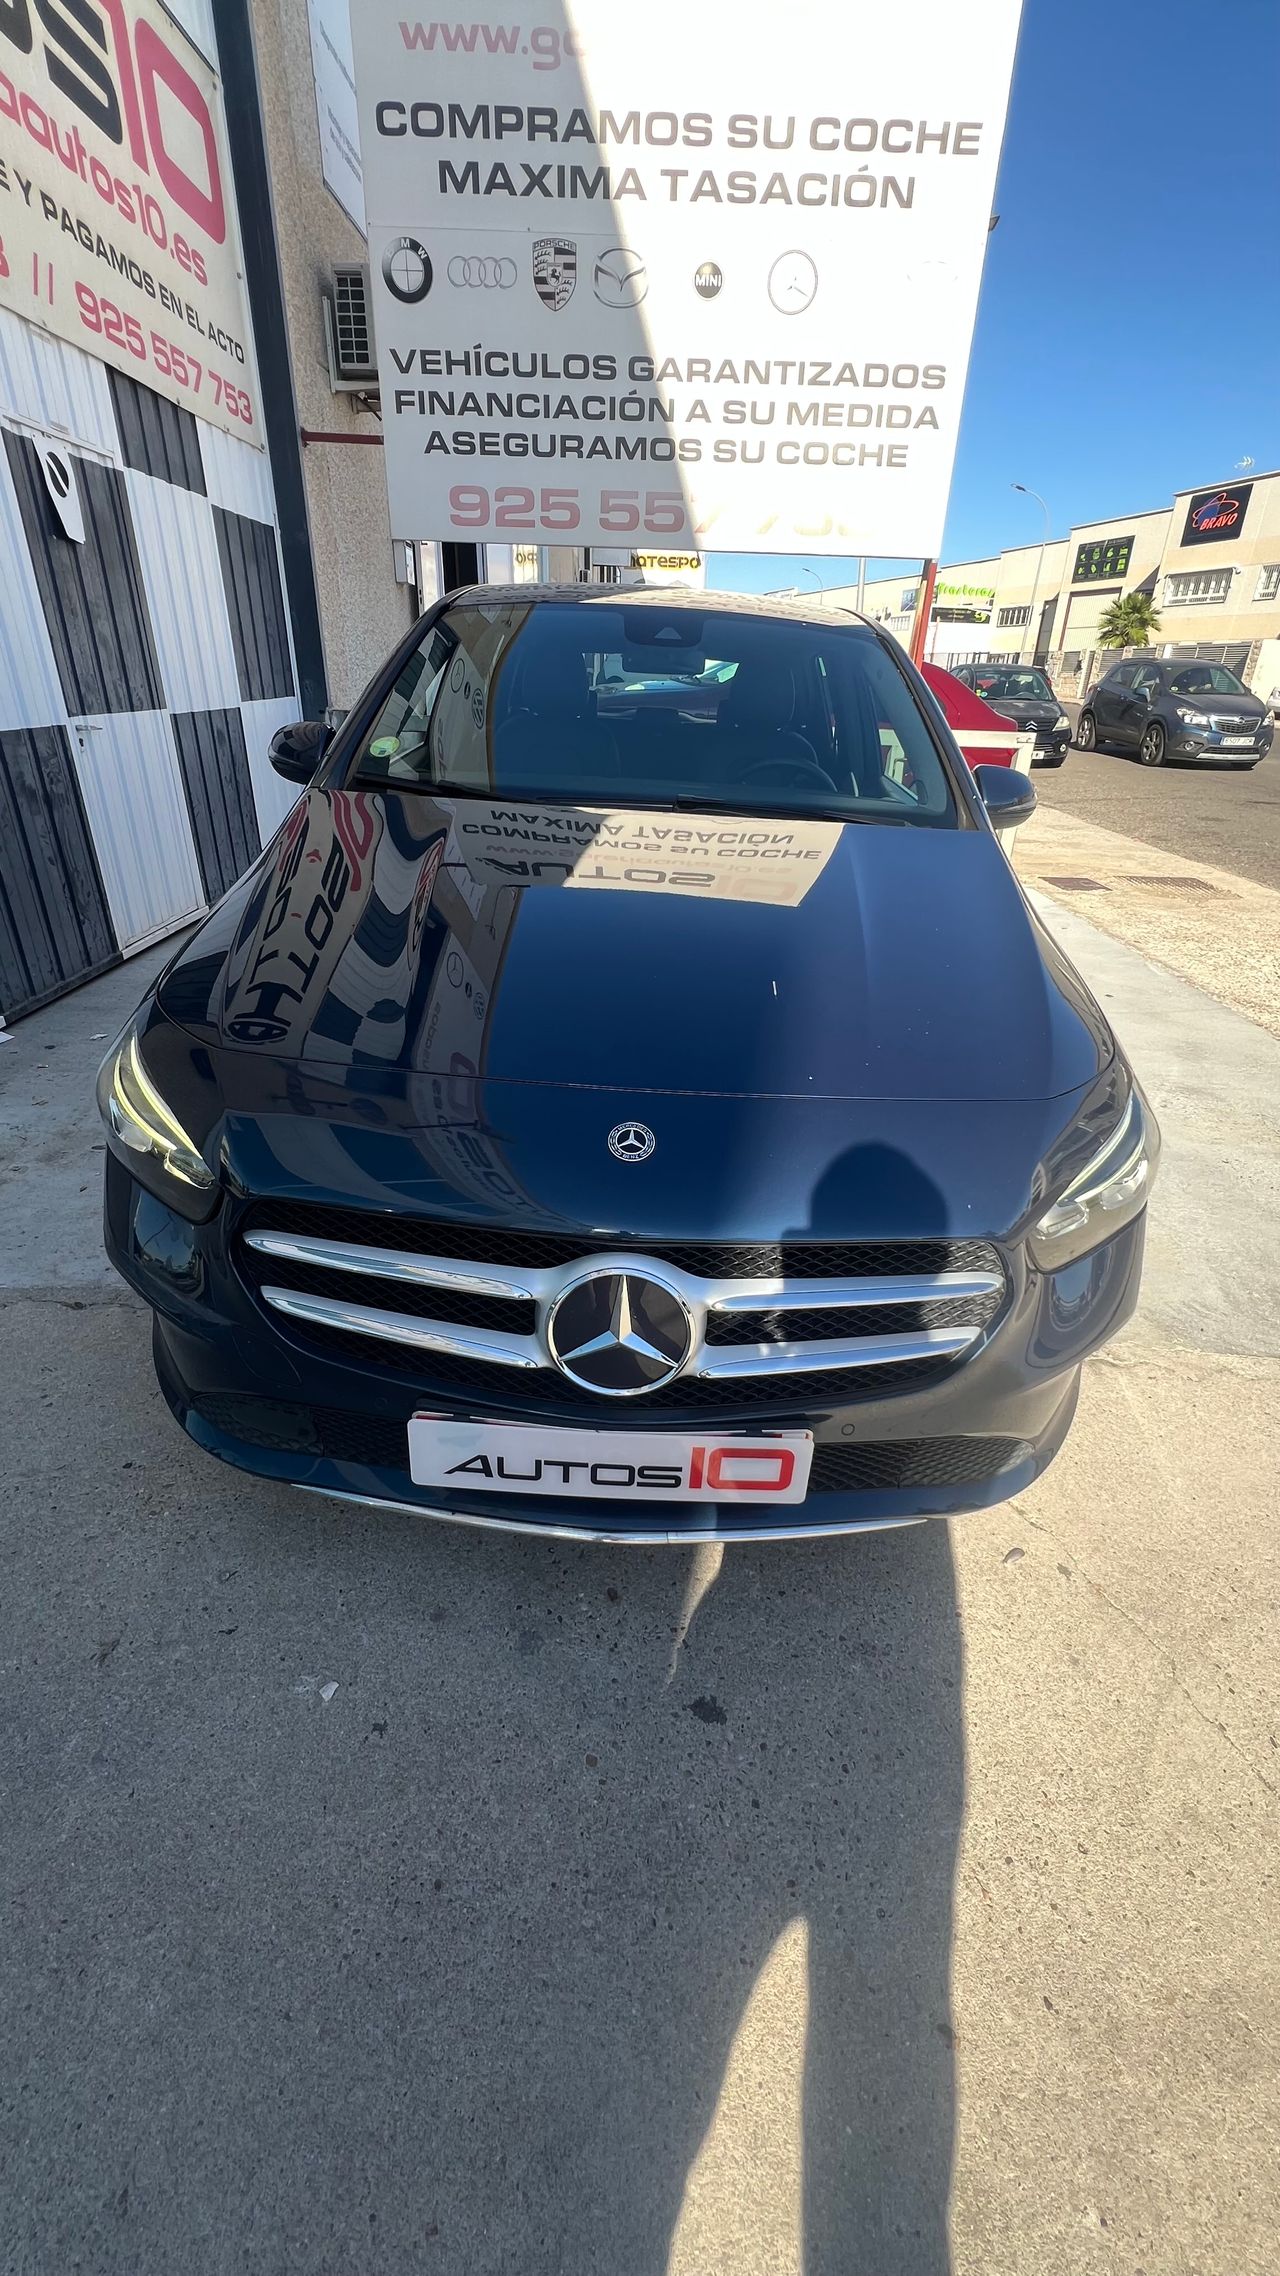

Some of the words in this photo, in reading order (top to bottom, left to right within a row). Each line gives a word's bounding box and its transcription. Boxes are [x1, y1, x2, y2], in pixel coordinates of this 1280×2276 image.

[376, 101, 712, 147] COMPRAMOS
[727, 114, 795, 150] SU
[809, 117, 983, 155] COCHE
[438, 160, 647, 200] MAXIMA
[661, 164, 915, 209] TASACIÓN
[13, 168, 31, 207] Y
[39, 189, 156, 299] PAGAMOS
[158, 282, 184, 320] EN
[185, 303, 206, 336] EL
[208, 322, 245, 364] ACTO
[694, 273, 723, 287] MINI
[75, 281, 147, 360] 925
[150, 330, 202, 393] 557
[208, 369, 253, 425] 753
[389, 343, 617, 381] VEHÍCULOS
[628, 356, 947, 390] GARANTIZADOS
[395, 389, 674, 422] FINANCIACIÓN
[685, 399, 712, 424] A
[723, 400, 775, 424] SU
[787, 402, 939, 430] MEDIDA
[424, 431, 702, 462] ASEGURAMOS
[713, 440, 765, 464] SU
[777, 441, 909, 468] COCHE
[448, 484, 581, 529] 925
[1199, 512, 1239, 531] BRAVO
[443, 1446, 796, 1491] AUTOS10
